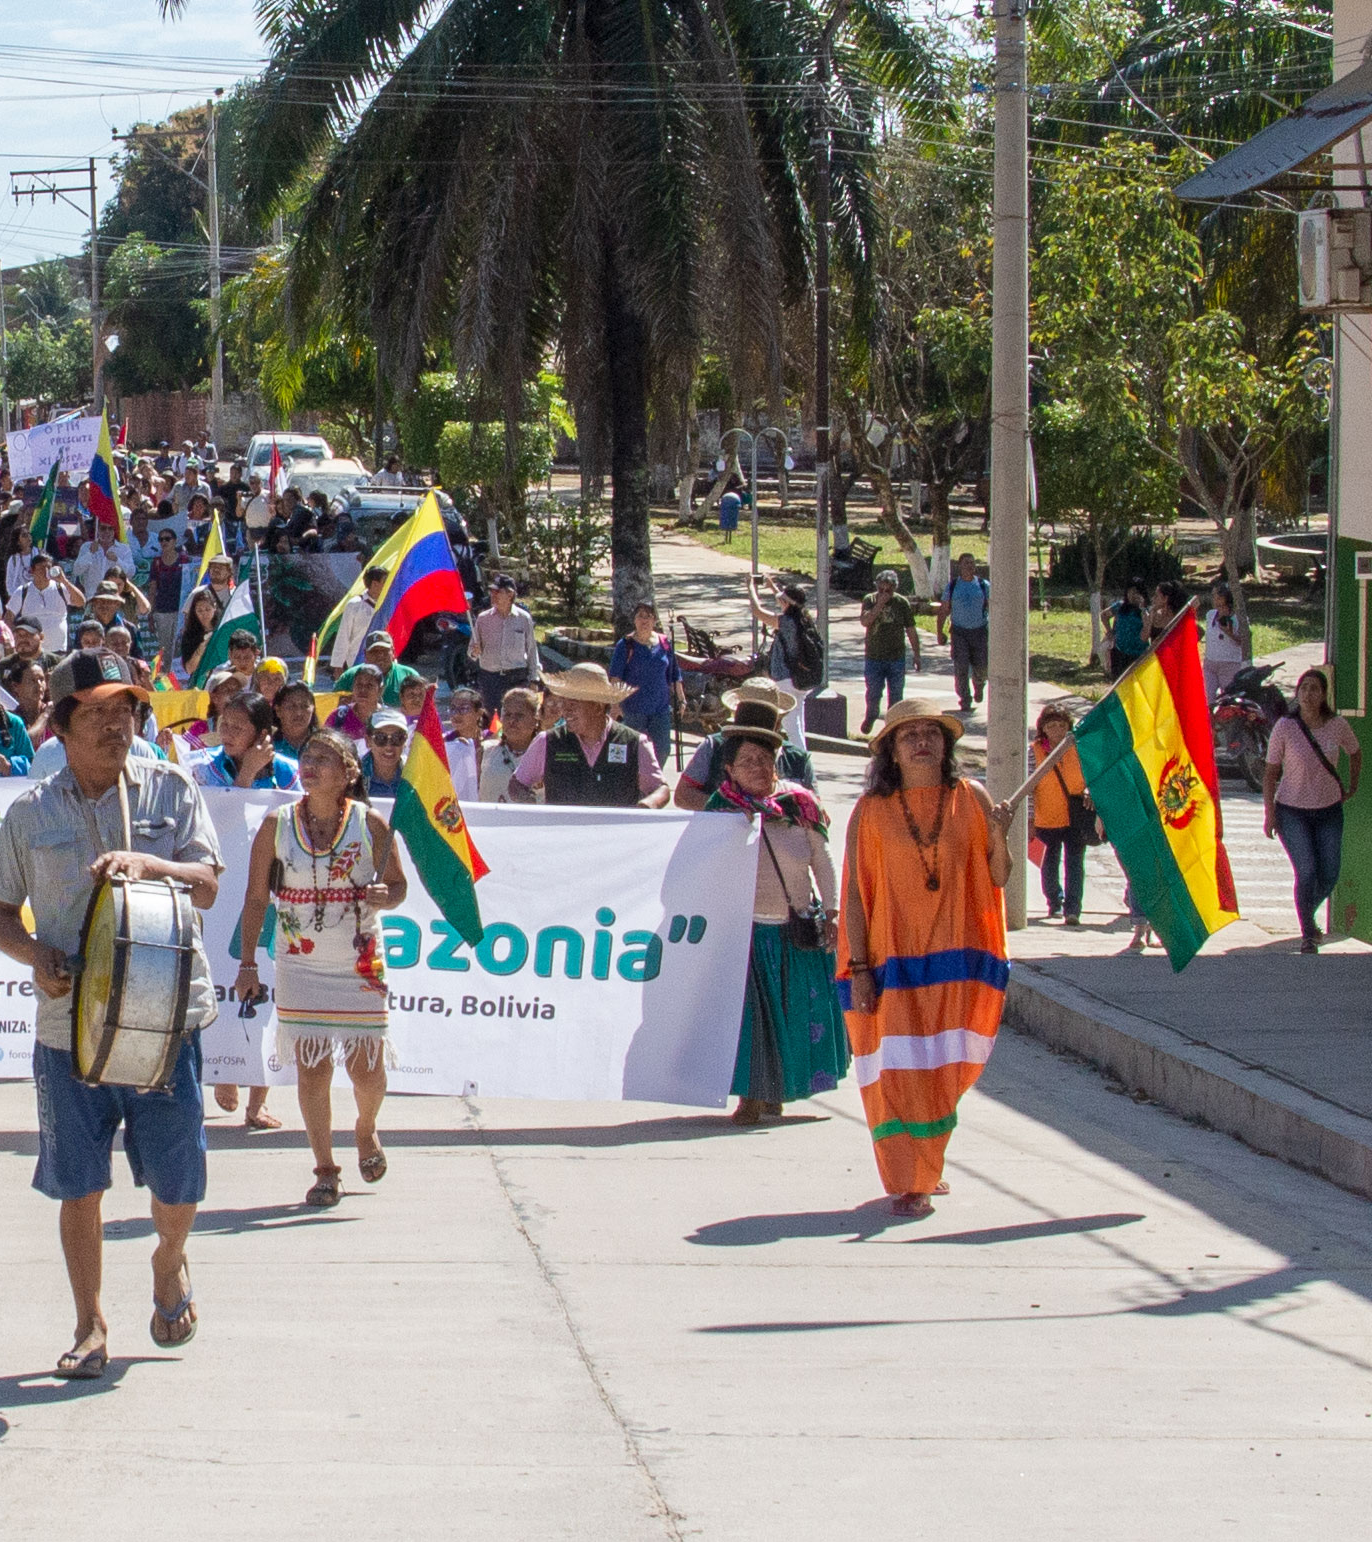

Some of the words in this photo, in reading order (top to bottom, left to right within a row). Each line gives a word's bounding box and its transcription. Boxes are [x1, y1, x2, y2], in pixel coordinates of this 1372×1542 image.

[50, 434, 92, 445] PRESENTE
[461, 995, 556, 1020] Bolivia
[9, 1050, 32, 1060] foros
